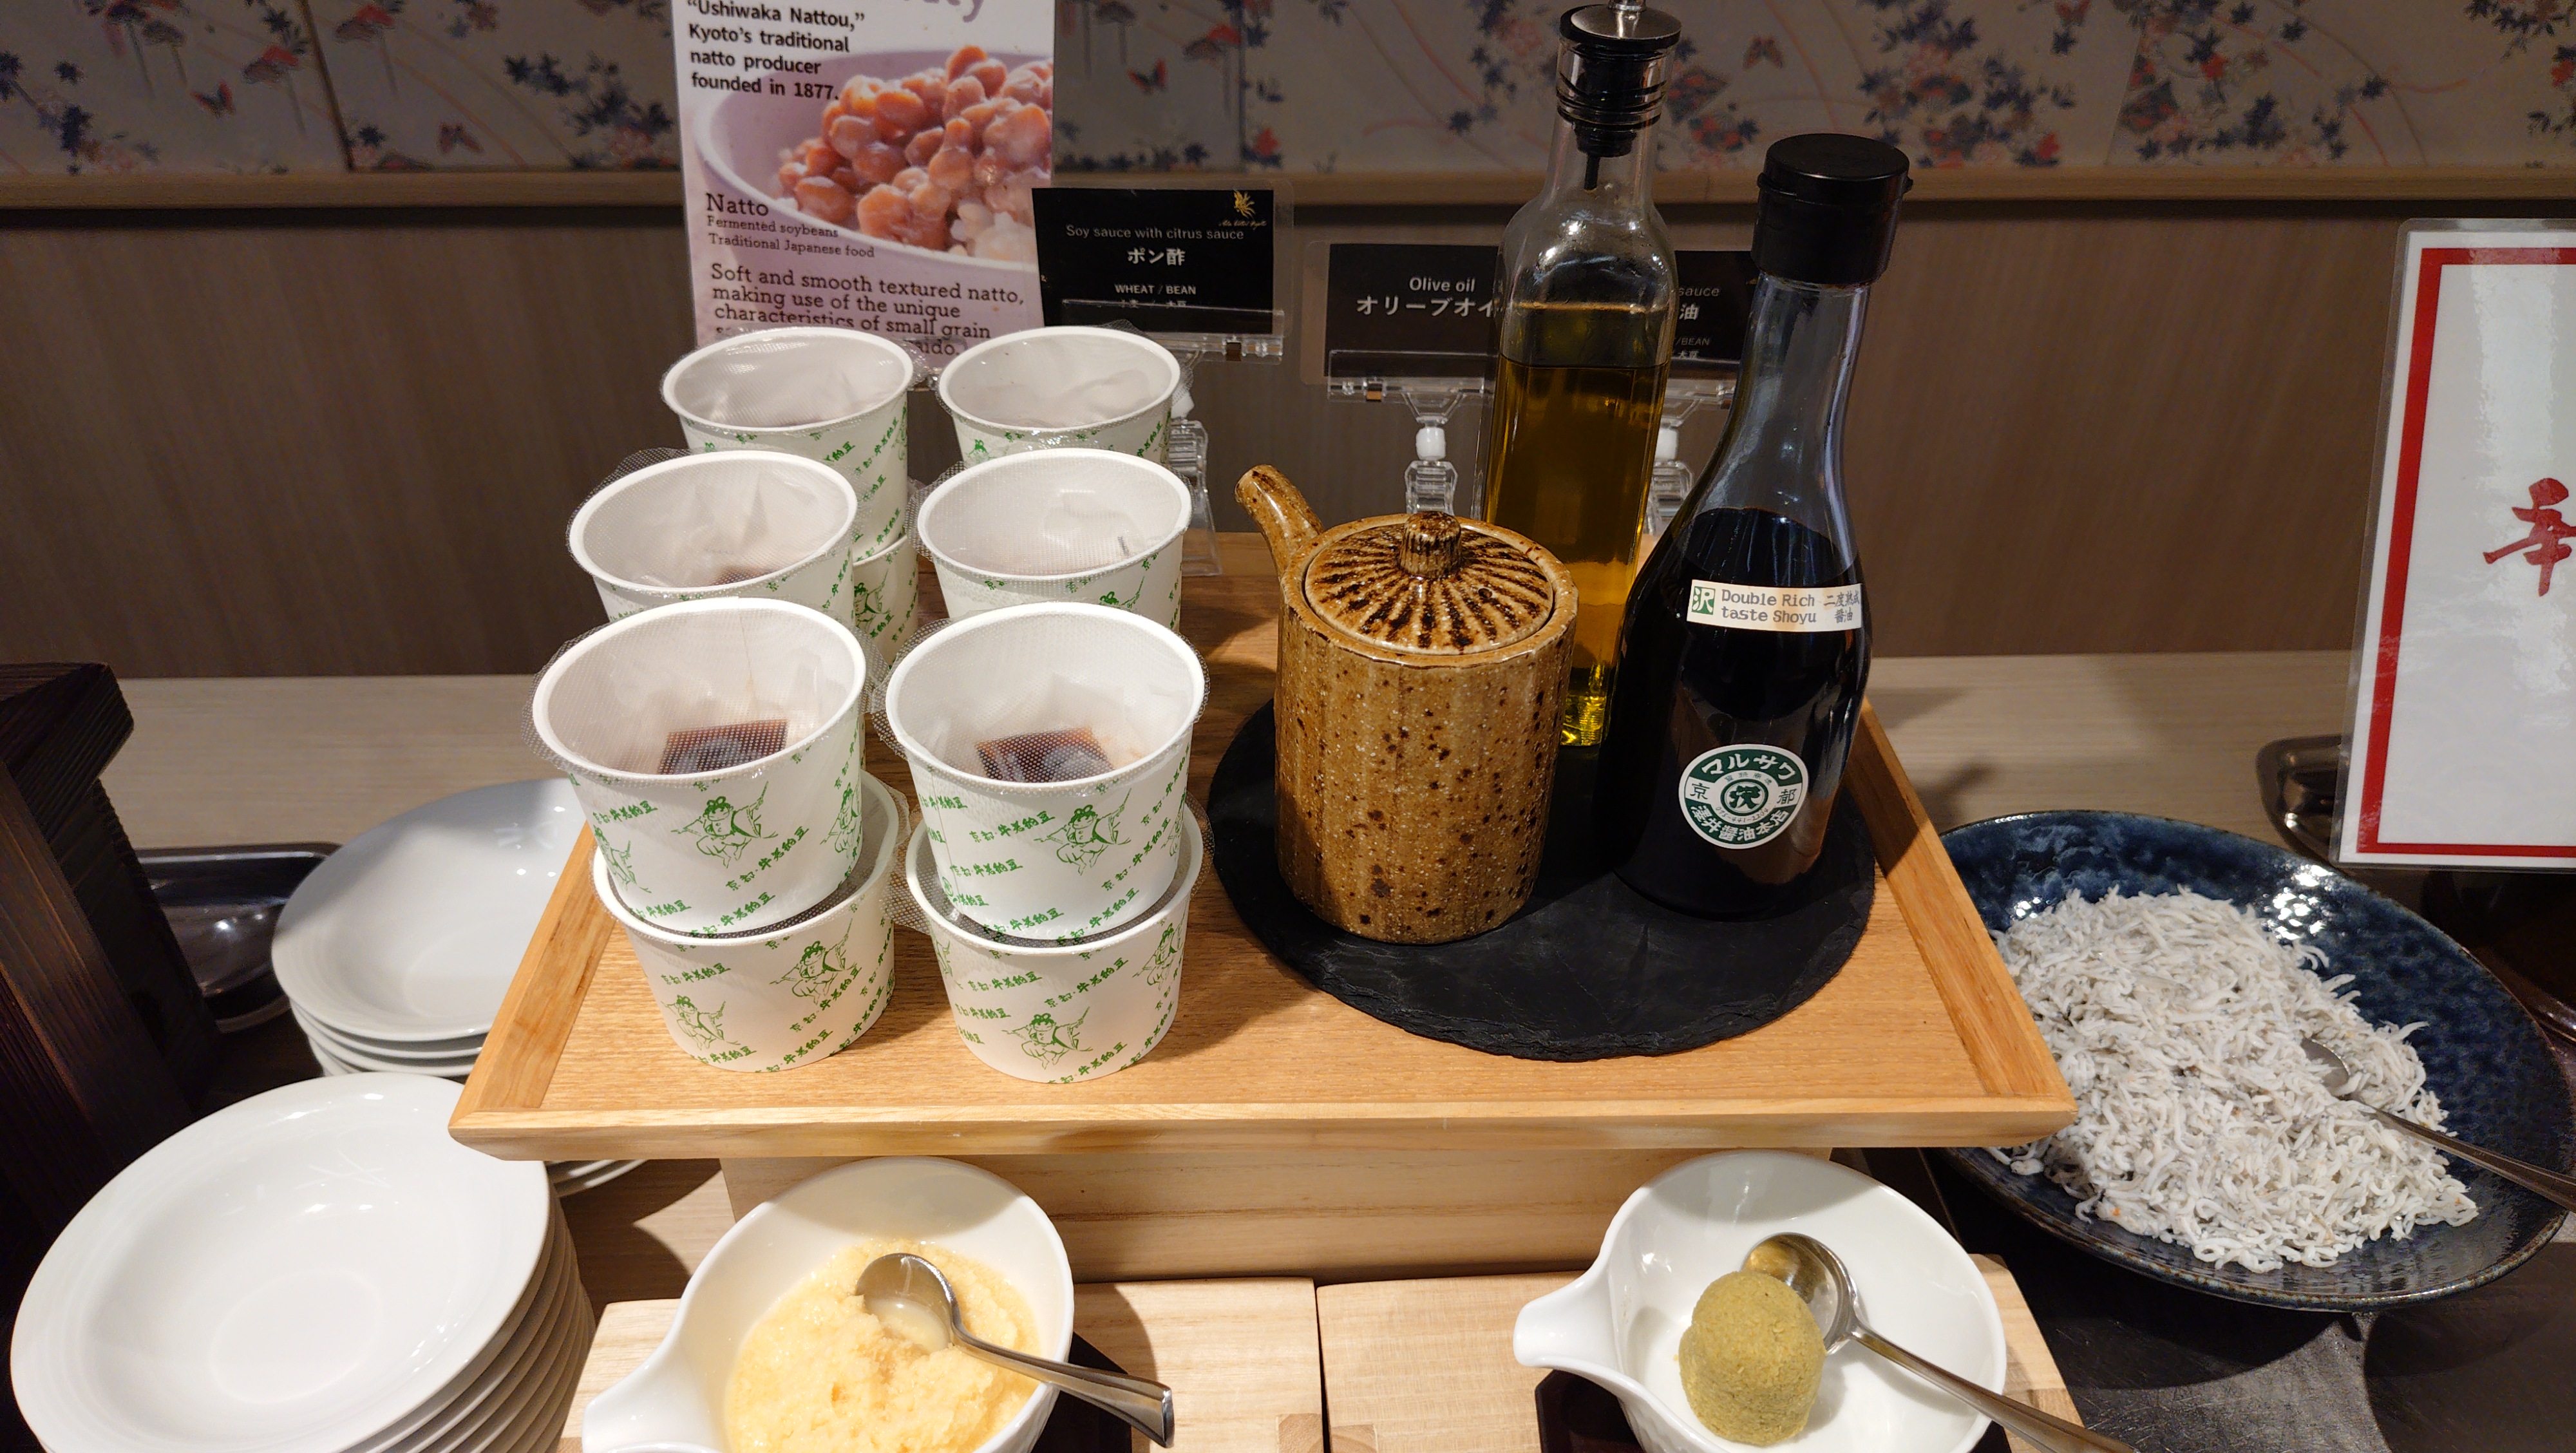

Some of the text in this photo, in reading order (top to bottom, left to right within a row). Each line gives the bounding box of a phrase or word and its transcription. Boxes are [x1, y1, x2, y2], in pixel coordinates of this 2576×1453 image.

[759, 30, 850, 52] traditional
[690, 51, 822, 74] natto producer
[692, 72, 839, 100] founded in 1877.
[706, 193, 769, 216] Natto
[707, 216, 838, 238] Fermented soybeans
[1066, 225, 1244, 240] Soy sauce with citrus sauce
[708, 233, 875, 258] Traditional Japanese food
[1128, 247, 1186, 266] ポン酢
[712, 263, 1024, 305] Soft and smooth textured natto,
[1115, 284, 1155, 294] WHEAT
[1166, 285, 1197, 295] BEAN
[1410, 277, 1475, 292] Olive oil
[1678, 288, 1720, 296] sauce
[712, 286, 961, 321] making use of the unique
[715, 303, 990, 343] characteristics of small grain
[1692, 586, 1716, 615] 沢
[1721, 589, 1815, 607] Double Rich
[1823, 589, 1861, 607] 二度熟成
[1721, 605, 1817, 625] taste Shoyu
[1834, 607, 1853, 623] 醤油
